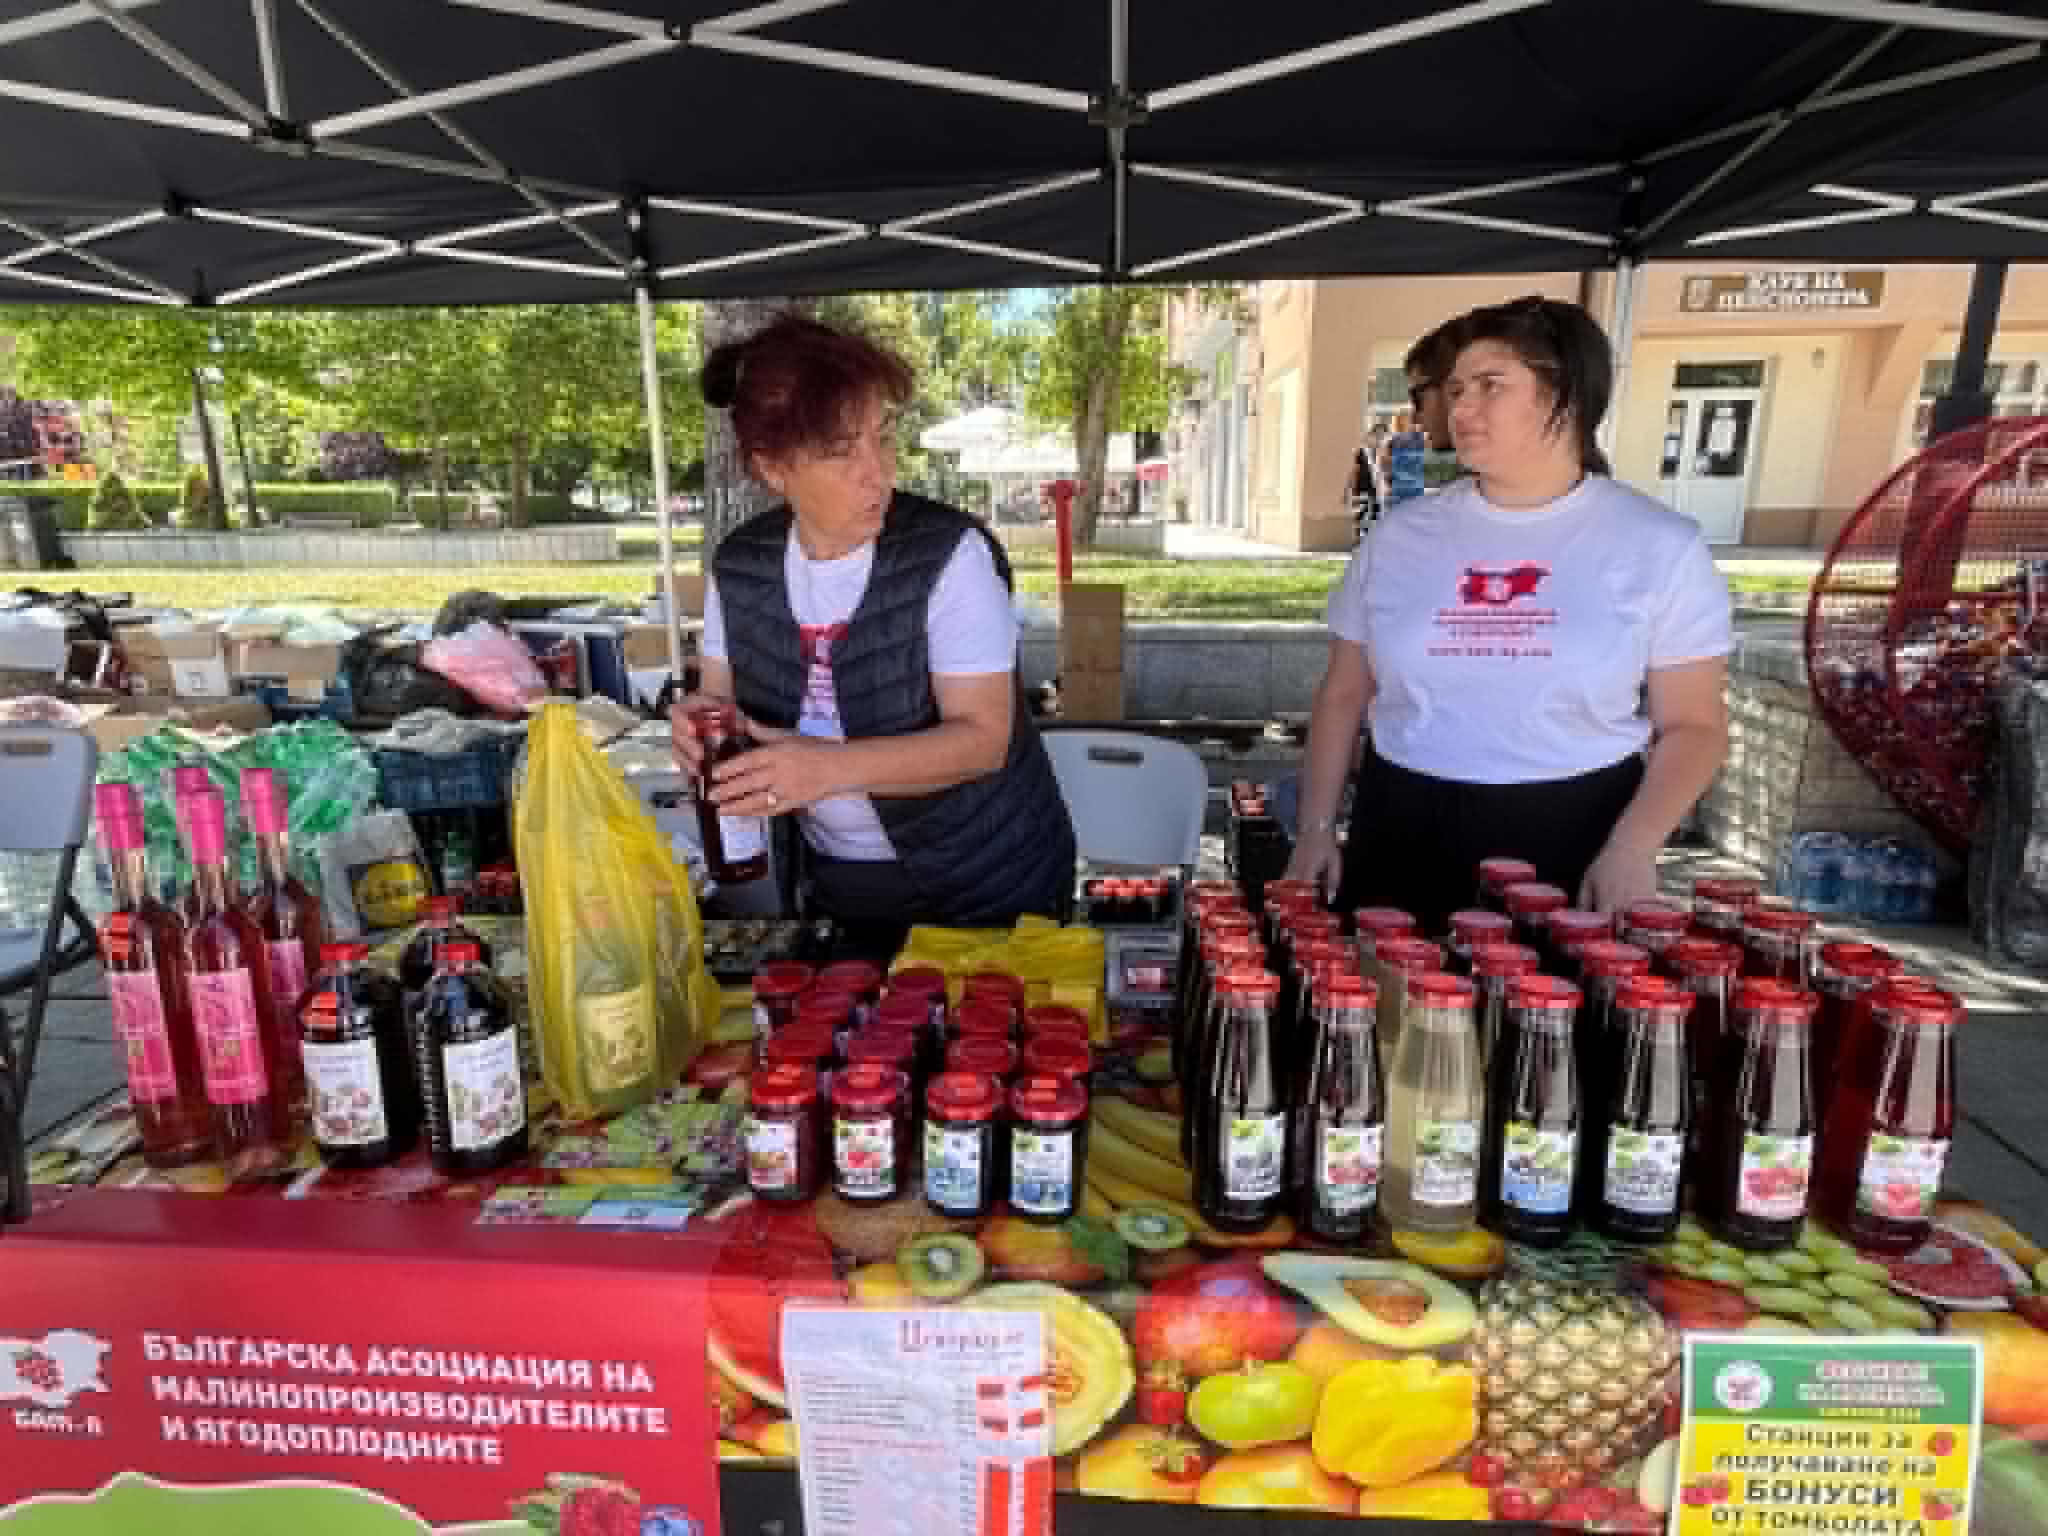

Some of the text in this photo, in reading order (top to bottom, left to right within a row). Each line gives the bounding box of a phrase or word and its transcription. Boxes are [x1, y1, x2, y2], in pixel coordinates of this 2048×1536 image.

[143, 1333, 655, 1392] БЪЛГАРСКА АСОЦИАЦИЯ НА
[152, 1376, 668, 1434] МАЛИНОПРОИЗВОДИТЕЛИТЕ
[161, 1417, 501, 1464] И ЯГОДОПЛОДНИТЕ
[1748, 1424, 1913, 1450] Станция за
[1712, 1453, 1937, 1478] получаване на
[1748, 1480, 1897, 1506] БОНУСИ
